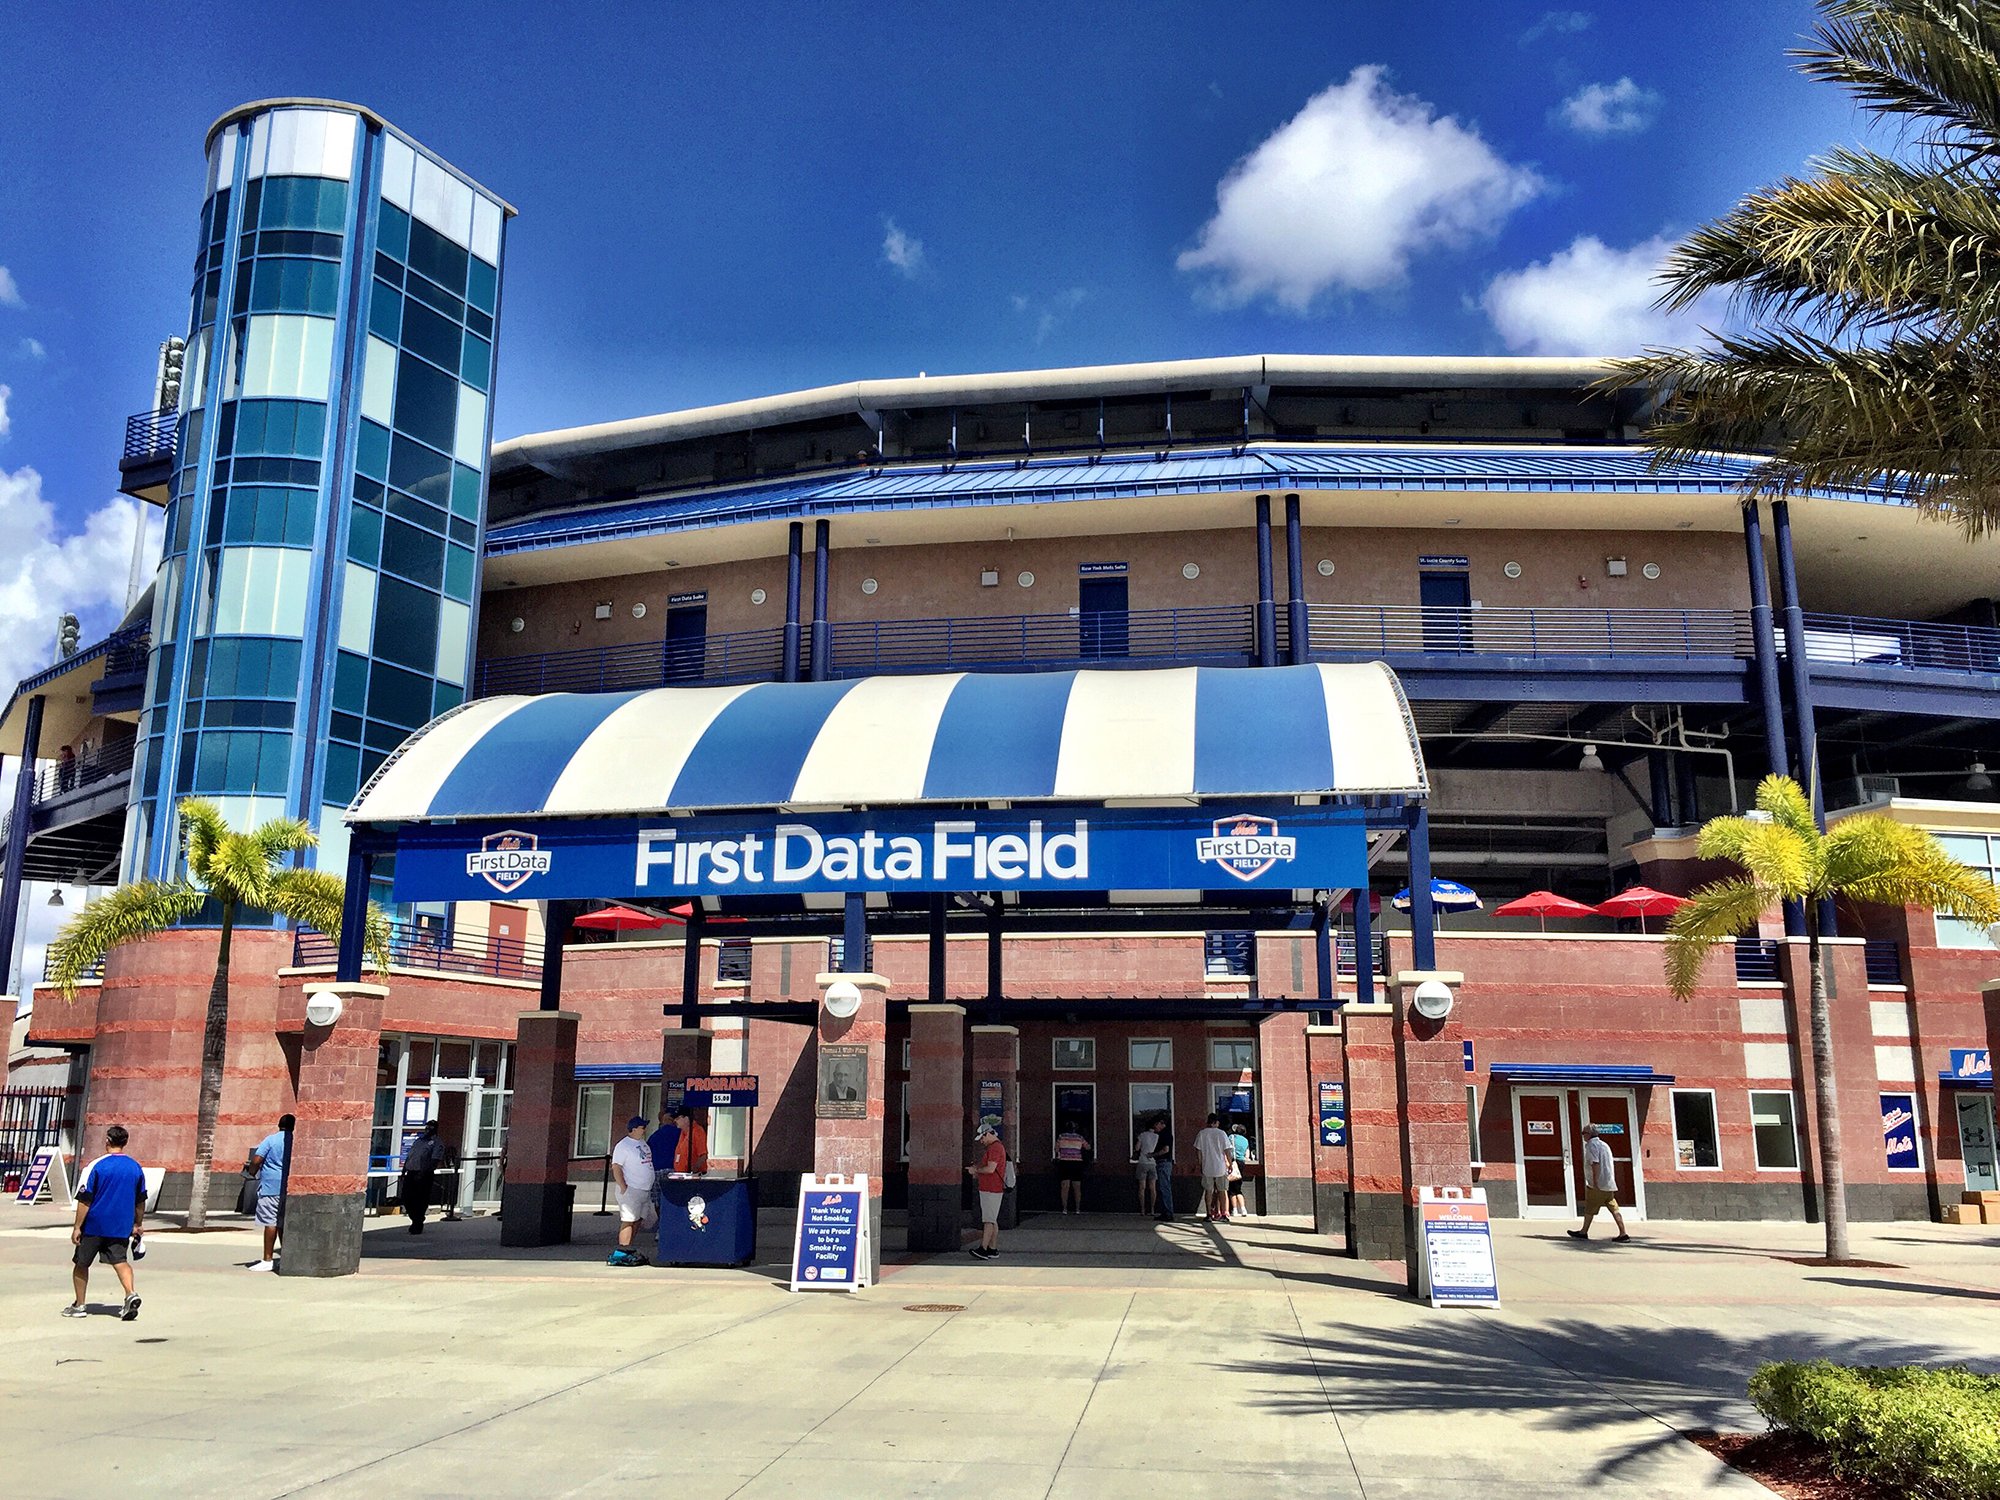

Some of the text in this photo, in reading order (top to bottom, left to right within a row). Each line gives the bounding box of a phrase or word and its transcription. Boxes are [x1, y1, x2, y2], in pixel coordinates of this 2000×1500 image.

[1231, 822, 1258, 835] Mets
[497, 837, 521, 850] Mets
[1200, 838, 1291, 857] First Data
[636, 819, 1088, 886] First Data Field
[470, 853, 547, 871] First Data
[1233, 859, 1261, 868] FIELD
[496, 872, 520, 880] FIELD
[1959, 1051, 1991, 1077] Met
[686, 1076, 757, 1091] PROGRAMS
[1886, 1136, 1913, 1155] Mets
[822, 1194, 842, 1206] Mets
[824, 1215, 850, 1223] Smoking
[815, 1253, 839, 1261] Facility
